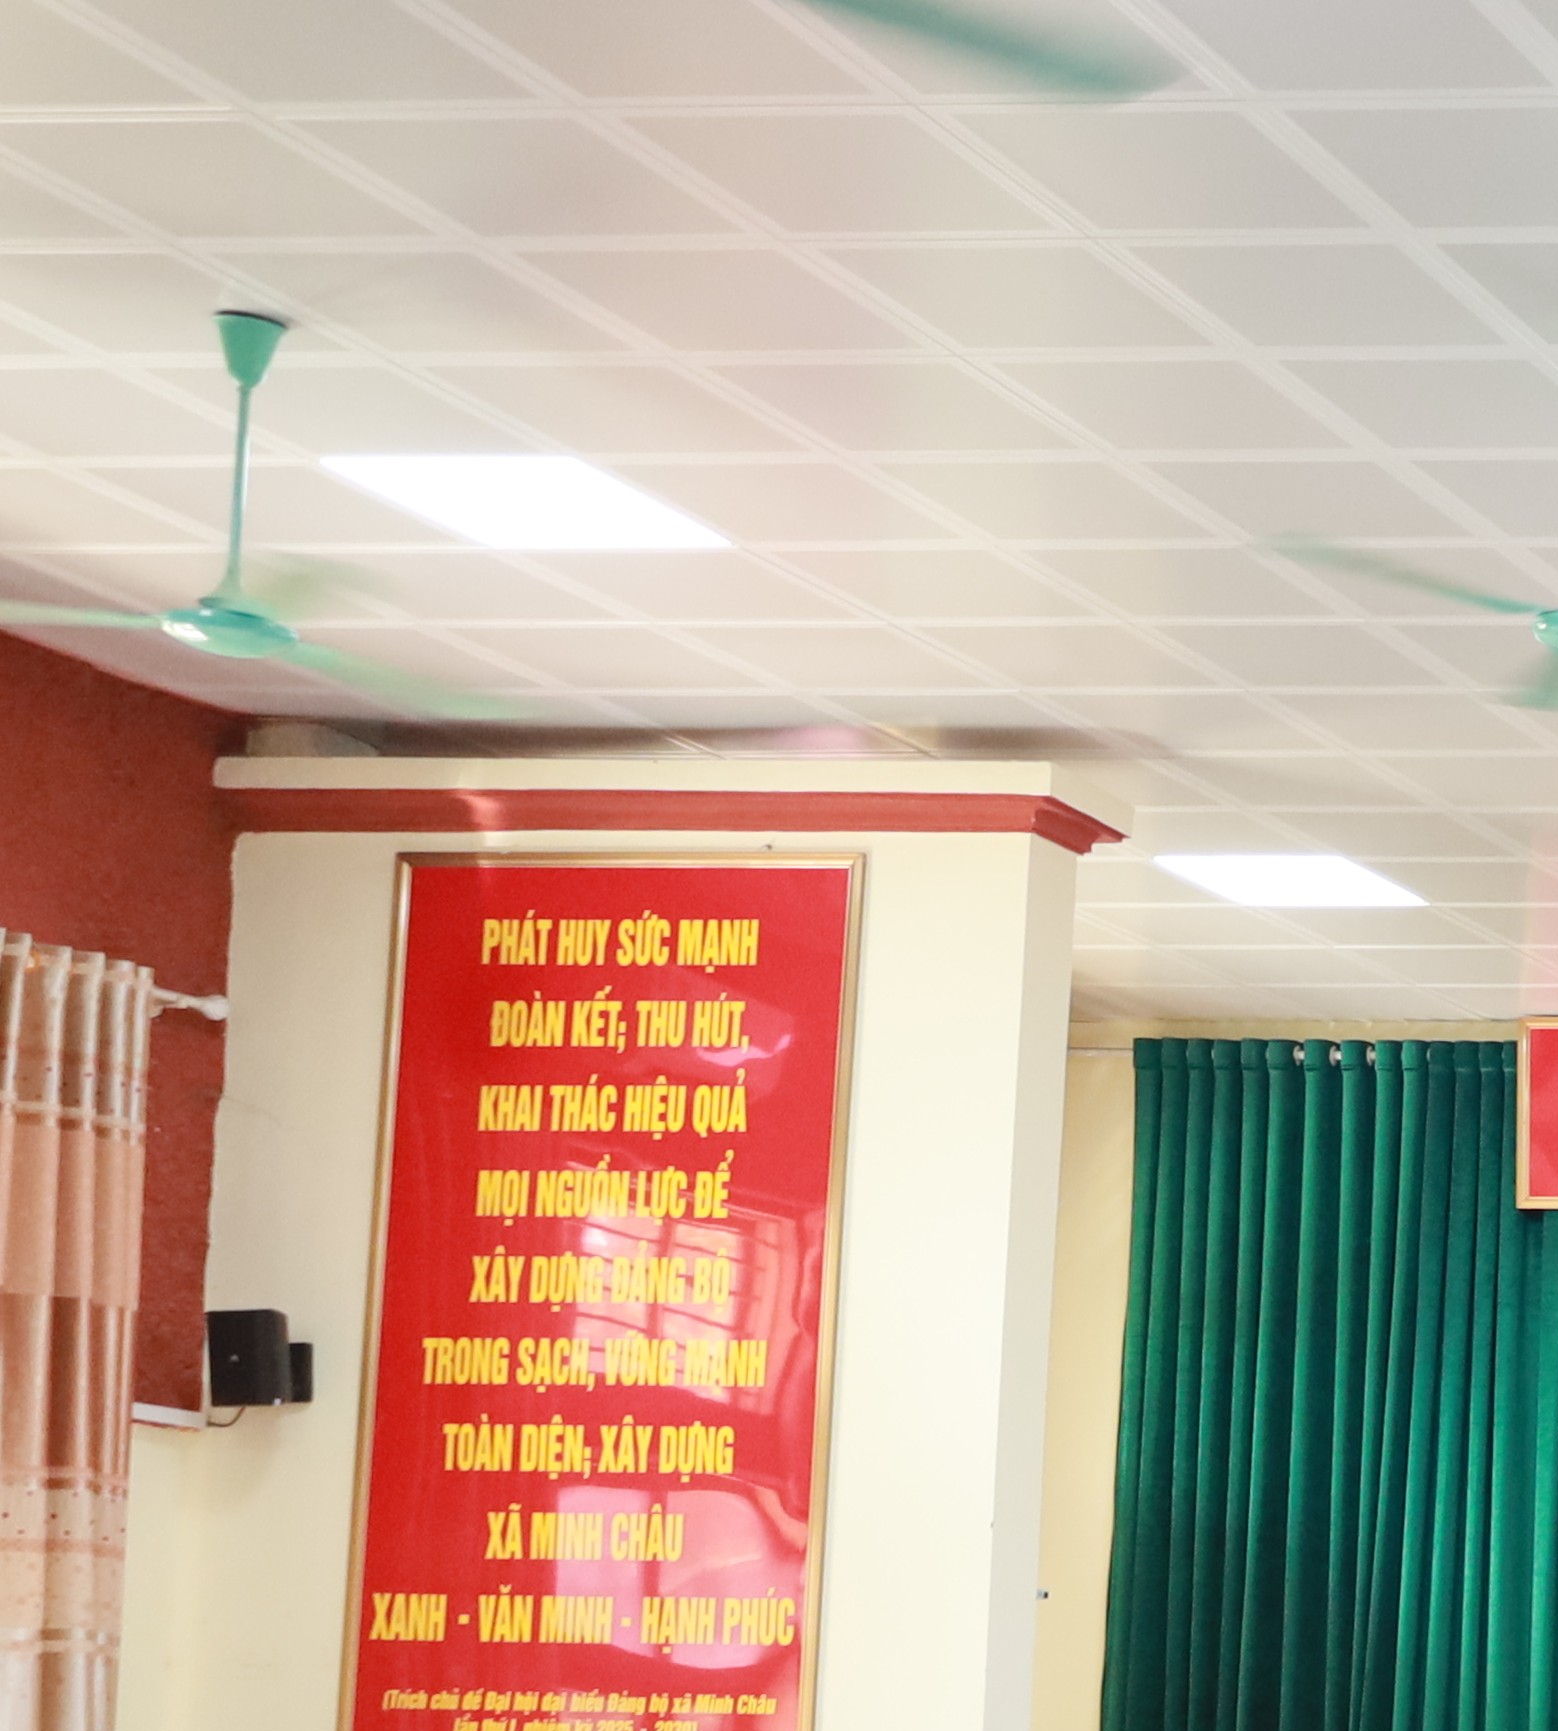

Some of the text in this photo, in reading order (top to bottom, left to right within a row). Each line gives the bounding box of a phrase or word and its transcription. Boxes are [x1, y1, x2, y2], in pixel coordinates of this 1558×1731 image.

[482, 910, 760, 972] PHÁT HUY SỨC MẠNH
[490, 986, 749, 1053] ĐOÀN KẾT; THU HÚT,
[478, 1070, 748, 1139] KHAI THÁC HIỆU QUẢ
[475, 1151, 735, 1225] MỌI NGUỒN LỰC ĐỂ
[469, 1242, 731, 1310] XÂY DỰNG ĐẢNG BỘ
[422, 1331, 768, 1394] TRONG SẠCH, VỮNG MẠNH
[442, 1415, 736, 1481] TOÀN DIỆN; XÂY DỰNG
[485, 1504, 683, 1561] XÃ MINH CHÂU
[369, 1586, 795, 1651] XANH VĂN MINH HẠNH PHÚC
[607, 1690, 647, 1715] Đảng
[694, 1693, 733, 1714] Minh
[736, 1693, 777, 1715] Châu
